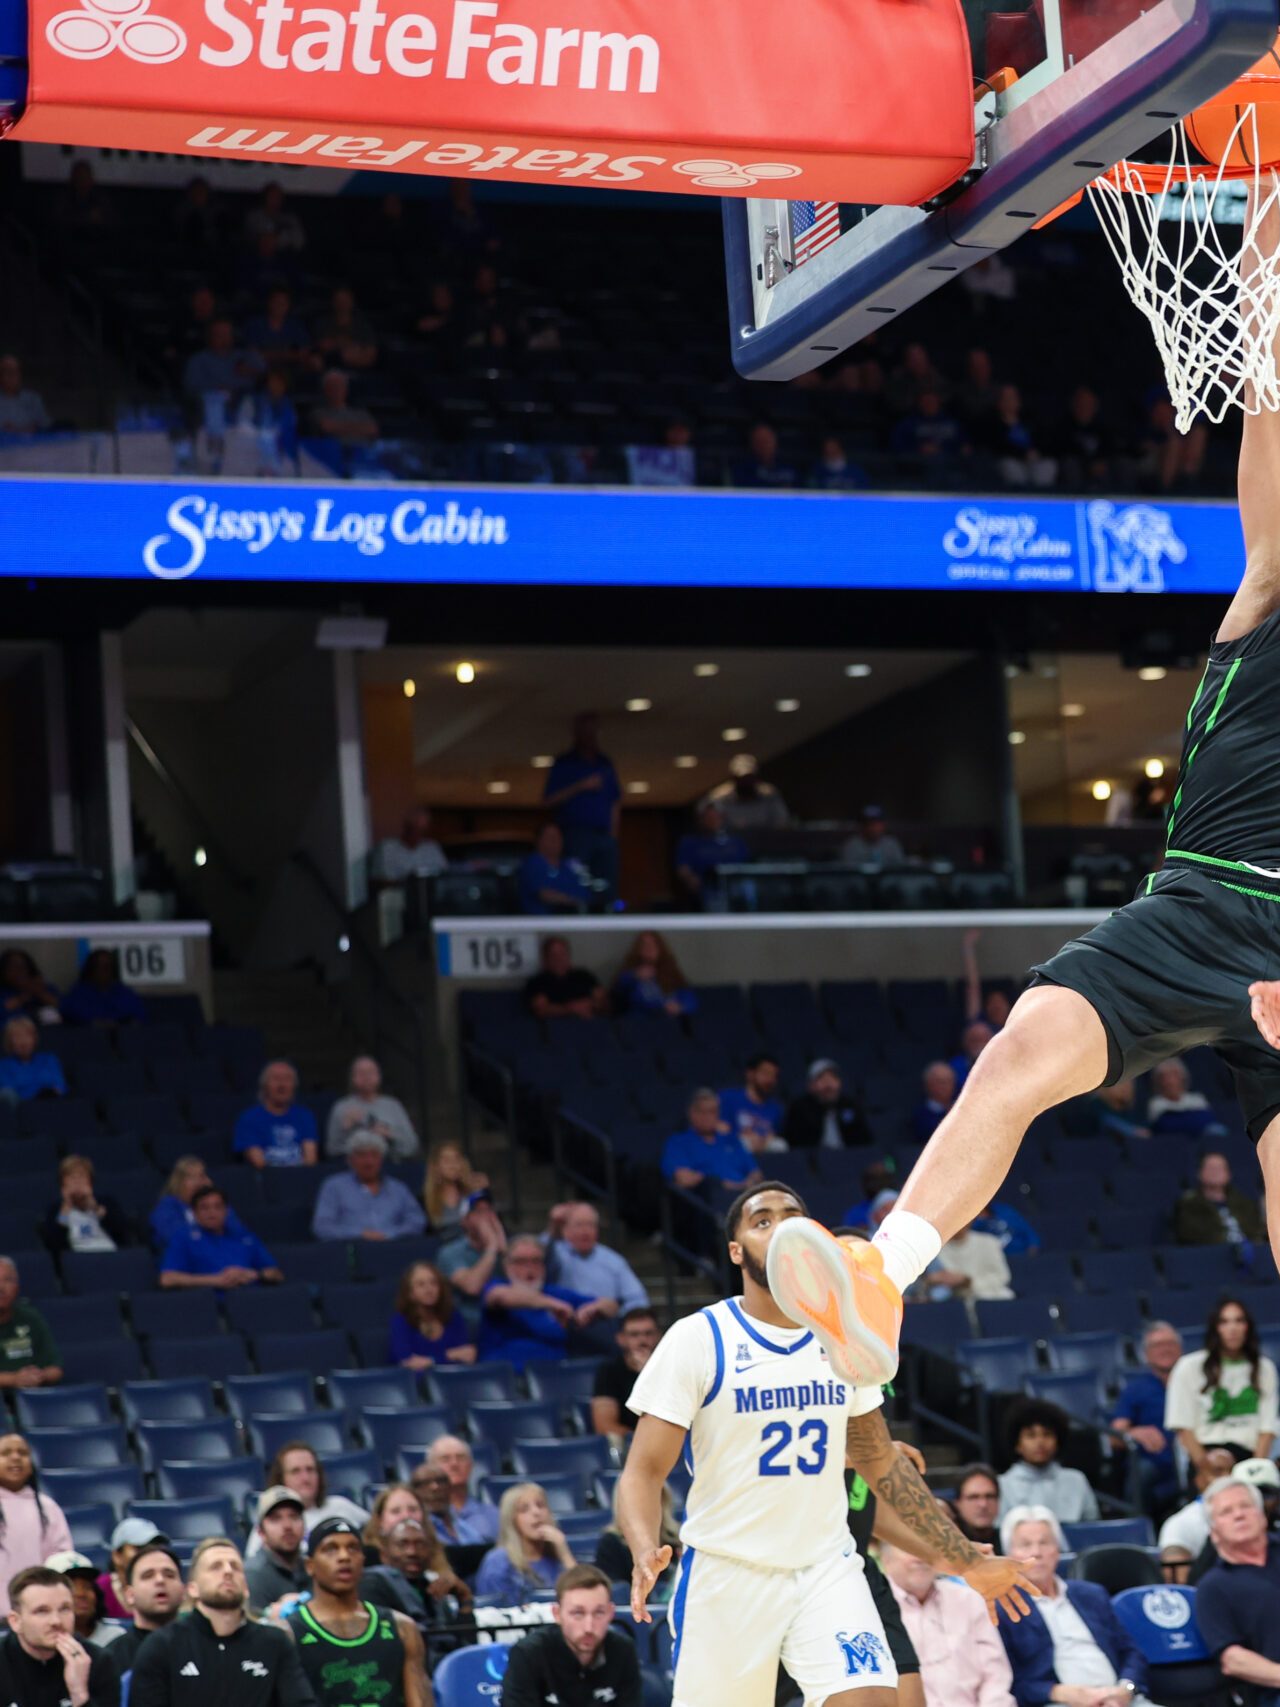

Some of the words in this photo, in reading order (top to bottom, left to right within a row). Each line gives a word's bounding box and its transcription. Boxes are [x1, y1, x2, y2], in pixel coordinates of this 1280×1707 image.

[143, 495, 305, 579] Sissy's
[311, 499, 387, 556] Log
[391, 499, 510, 546] Cabin
[467, 938, 523, 971] 105
[734, 1380, 846, 1414] Memphis
[758, 1419, 828, 1477] 23
